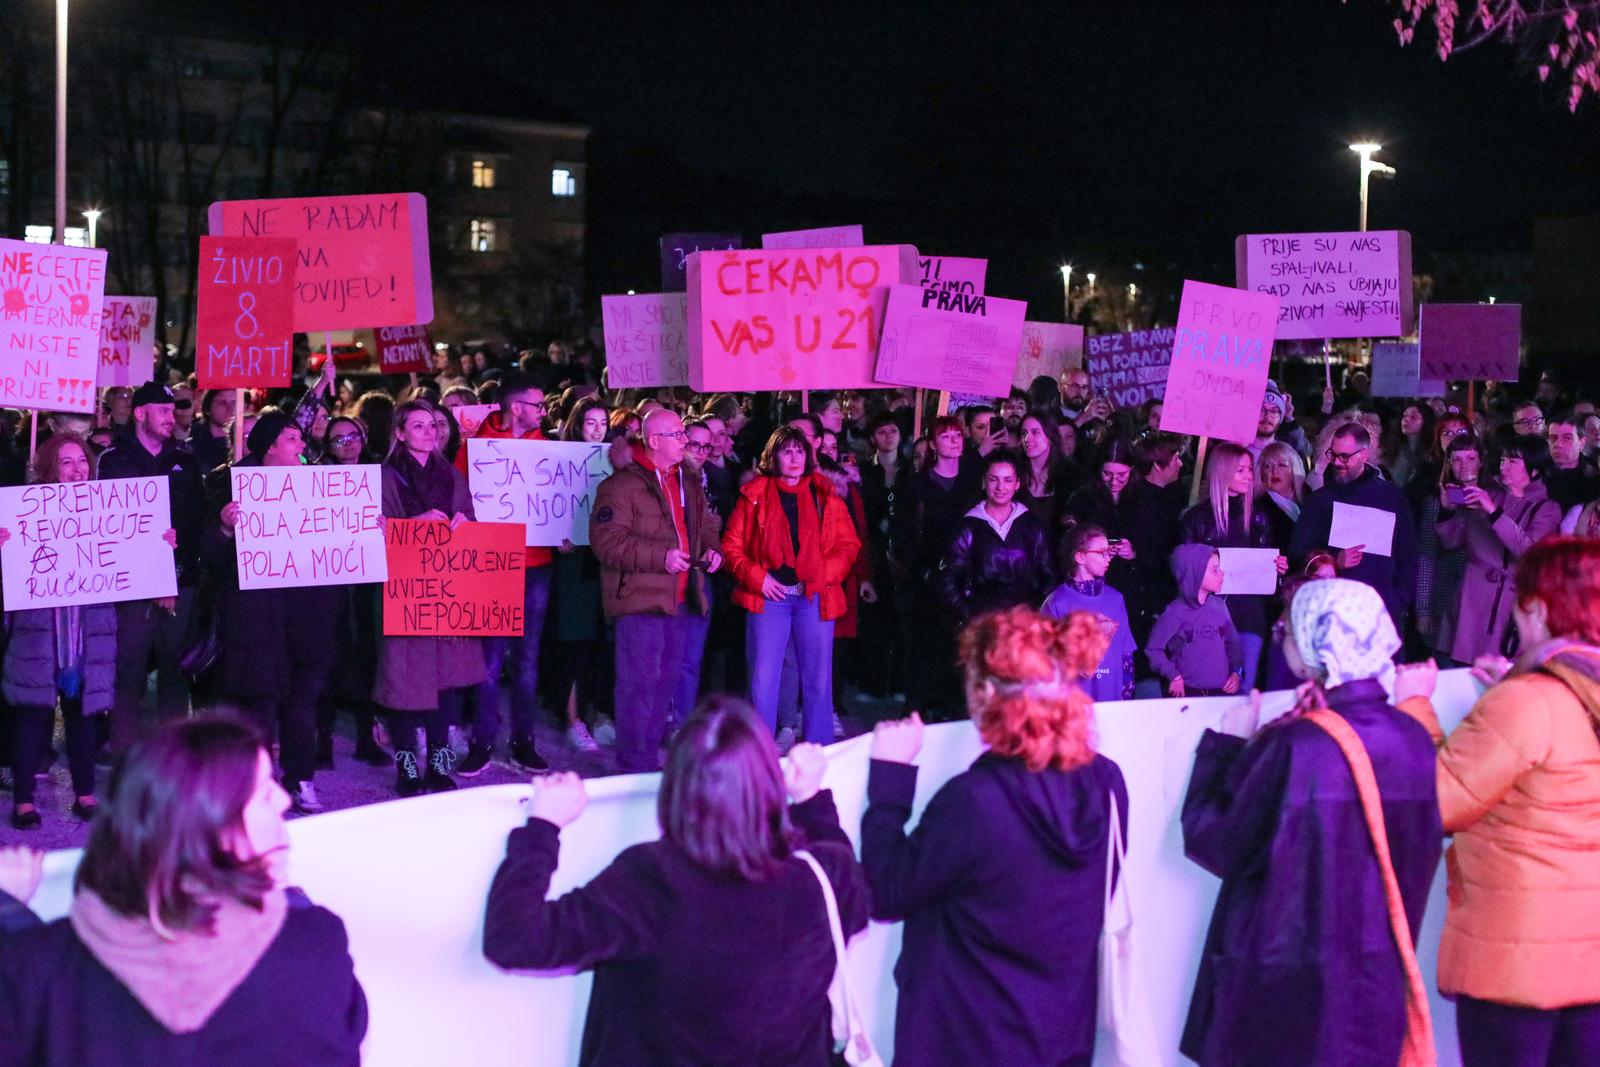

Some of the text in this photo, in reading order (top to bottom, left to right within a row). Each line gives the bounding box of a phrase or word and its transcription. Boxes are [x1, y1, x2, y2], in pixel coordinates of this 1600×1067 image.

[242, 207, 280, 237] NE
[296, 247, 328, 267] NA
[1262, 238, 1381, 258] PRIJE SU NAS
[3, 253, 33, 275] NE
[212, 247, 283, 285] ŽIVIO
[717, 252, 880, 299] ČEKAMO
[36, 283, 53, 305] U
[1302, 281, 1336, 296] NAS
[1349, 277, 1398, 297] UBIJAJU
[234, 291, 265, 339] 8.
[921, 288, 986, 317] PRAVA
[1191, 301, 1262, 332] PRVO
[1276, 304, 1325, 324] ZIVOM
[709, 305, 876, 355] VAS U 21
[1089, 333, 1124, 355] BEZ
[9, 334, 82, 359] NISTE
[207, 340, 289, 378] MART!
[1175, 327, 1263, 370] PRAVA
[24, 359, 49, 377] NI
[1192, 370, 1245, 399] ONDA
[235, 471, 373, 504] POLA NEBA
[494, 458, 589, 488] JA SAM
[16, 480, 158, 517] SPREMAMO
[497, 492, 515, 520] S
[18, 514, 154, 547] REVOLUCIJE
[238, 510, 293, 542] POLA
[390, 522, 451, 547] NIKAD
[76, 541, 119, 568] NE
[240, 540, 365, 581] POLA MOĆI
[419, 547, 524, 574] POKORENE
[26, 570, 131, 600] RUČKOVE
[388, 578, 456, 599] UVIJEK
[403, 600, 522, 632] NEPOSLUŠNE
